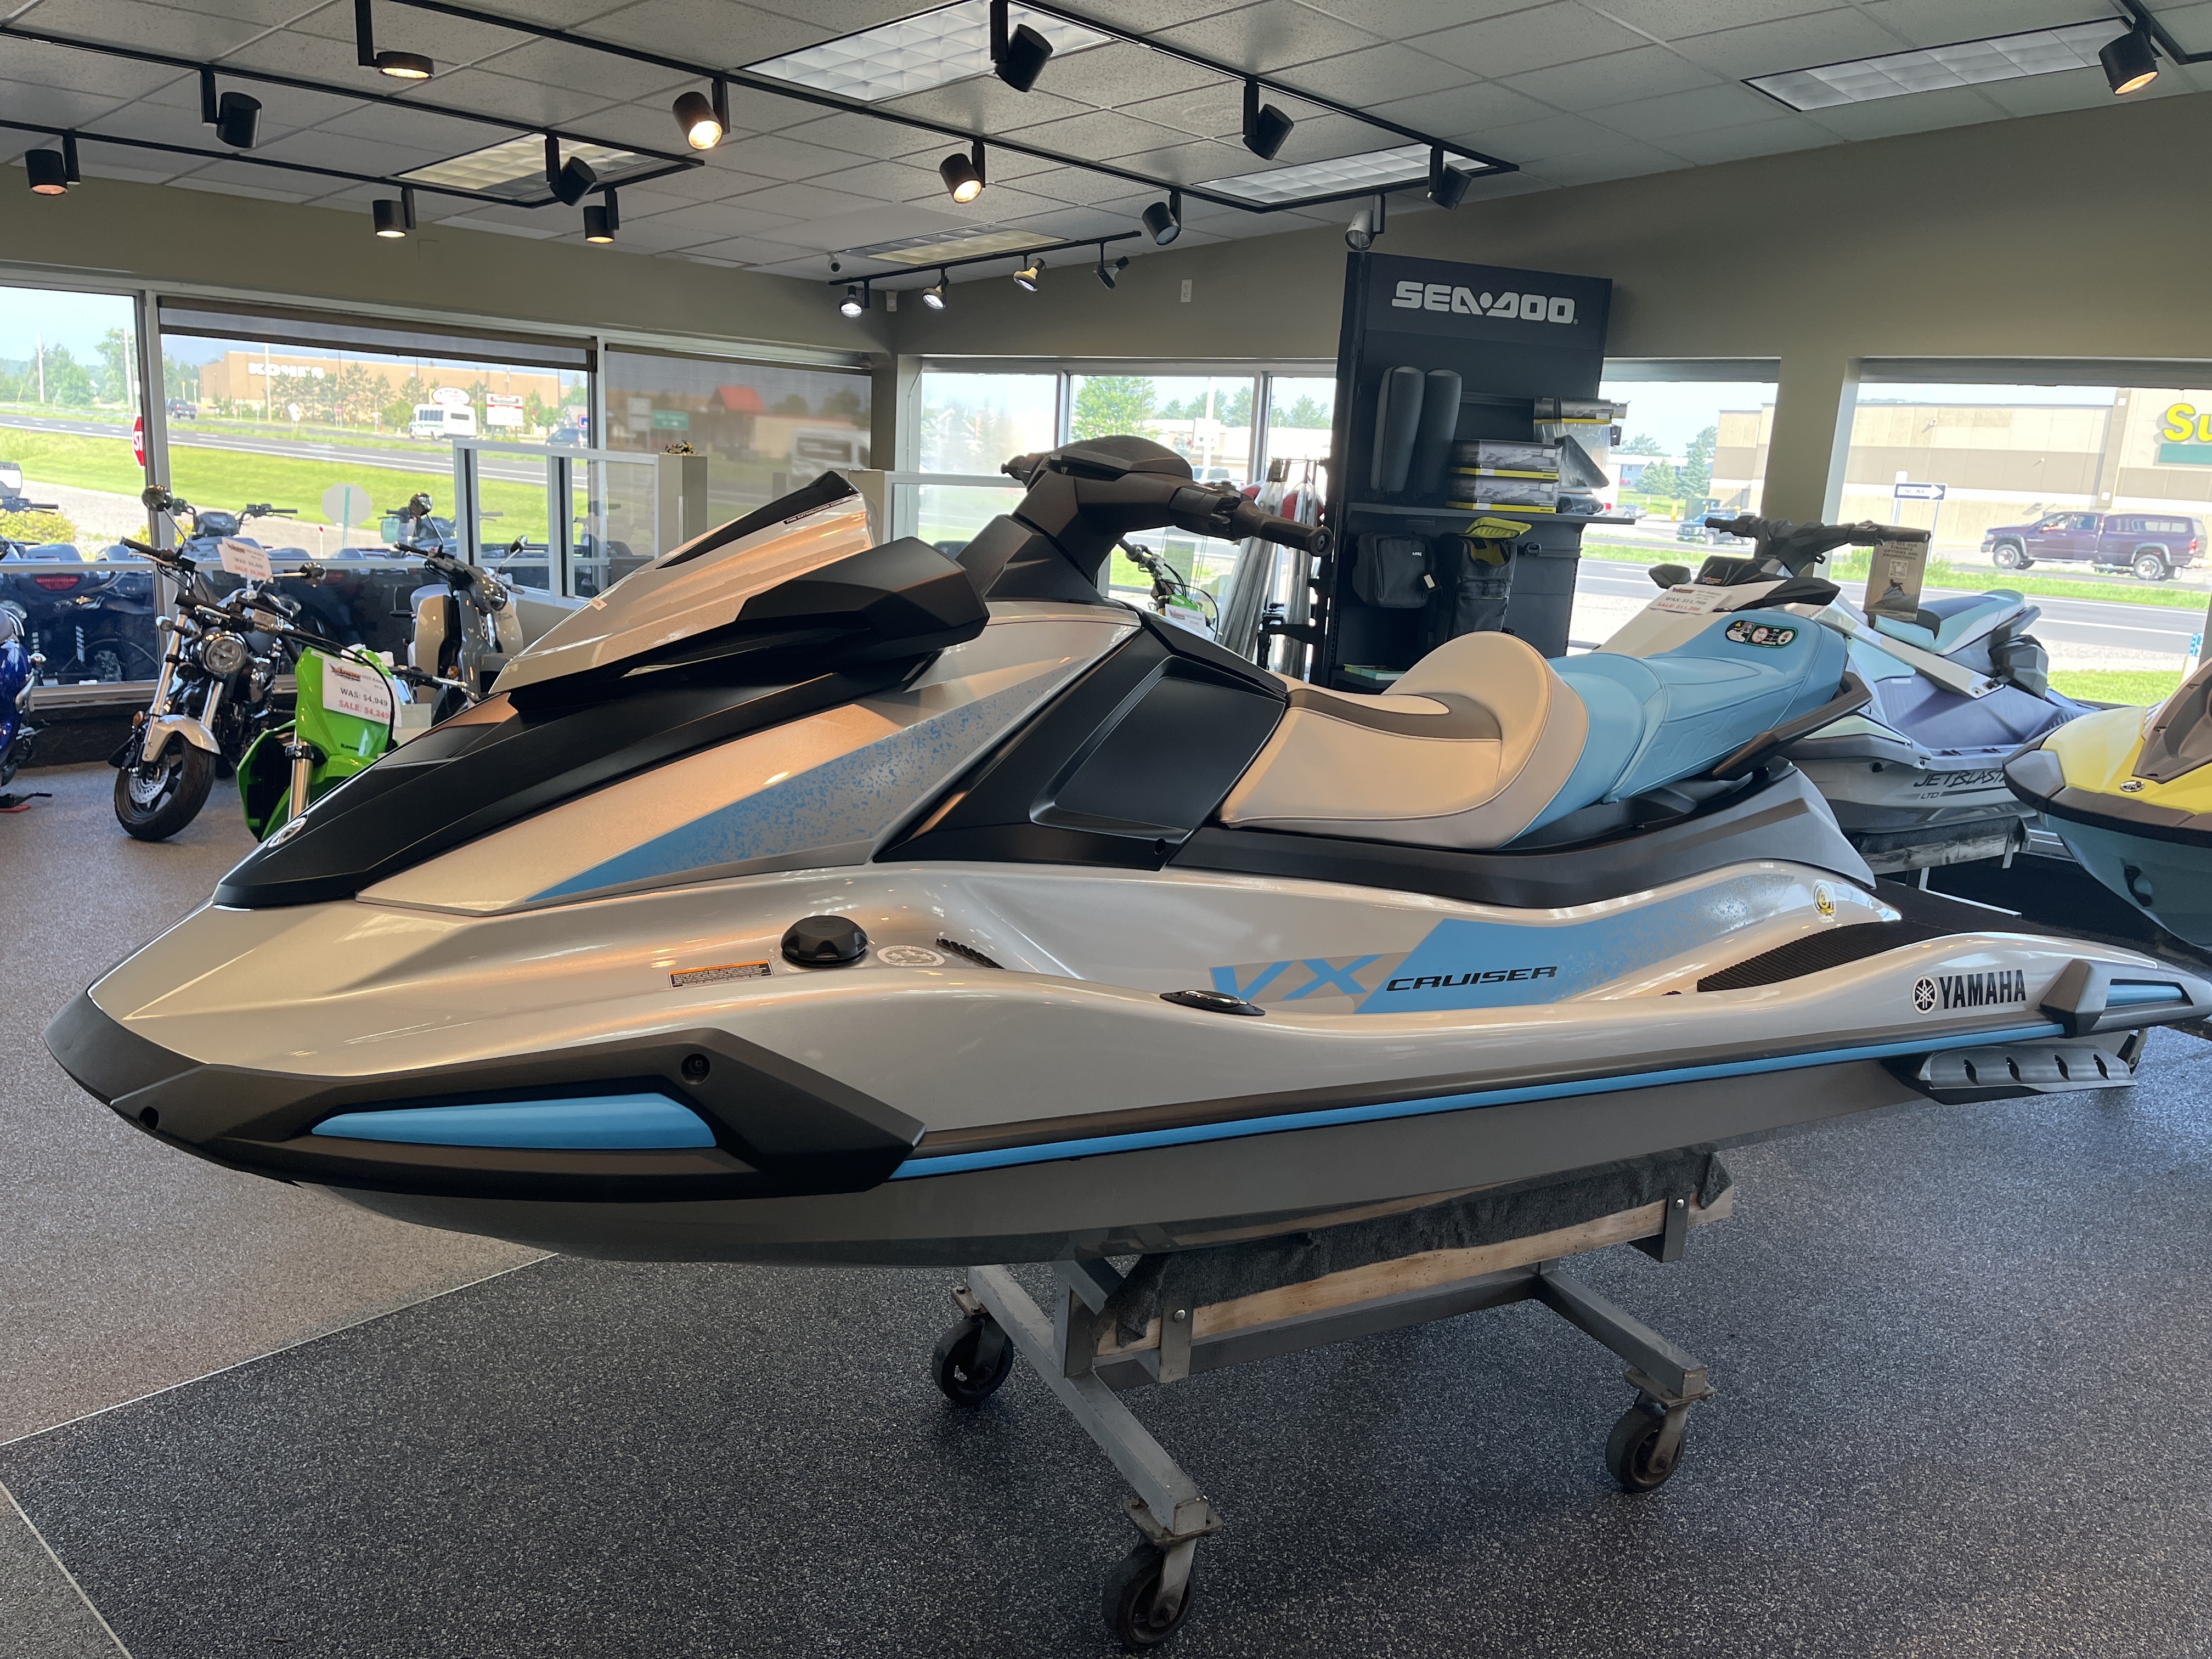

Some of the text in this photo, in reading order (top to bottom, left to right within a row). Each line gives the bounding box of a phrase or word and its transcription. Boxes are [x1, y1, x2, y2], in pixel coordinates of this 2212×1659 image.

[340, 687, 361, 699] WAS:
[363, 695, 388, 707] $4,949
[338, 699, 390, 719] SALE: $4,249
[1921, 792, 1940, 800] LTD
[1211, 953, 1558, 1003] VX CRUISER
[1938, 969, 2027, 1009] YAMAHA
